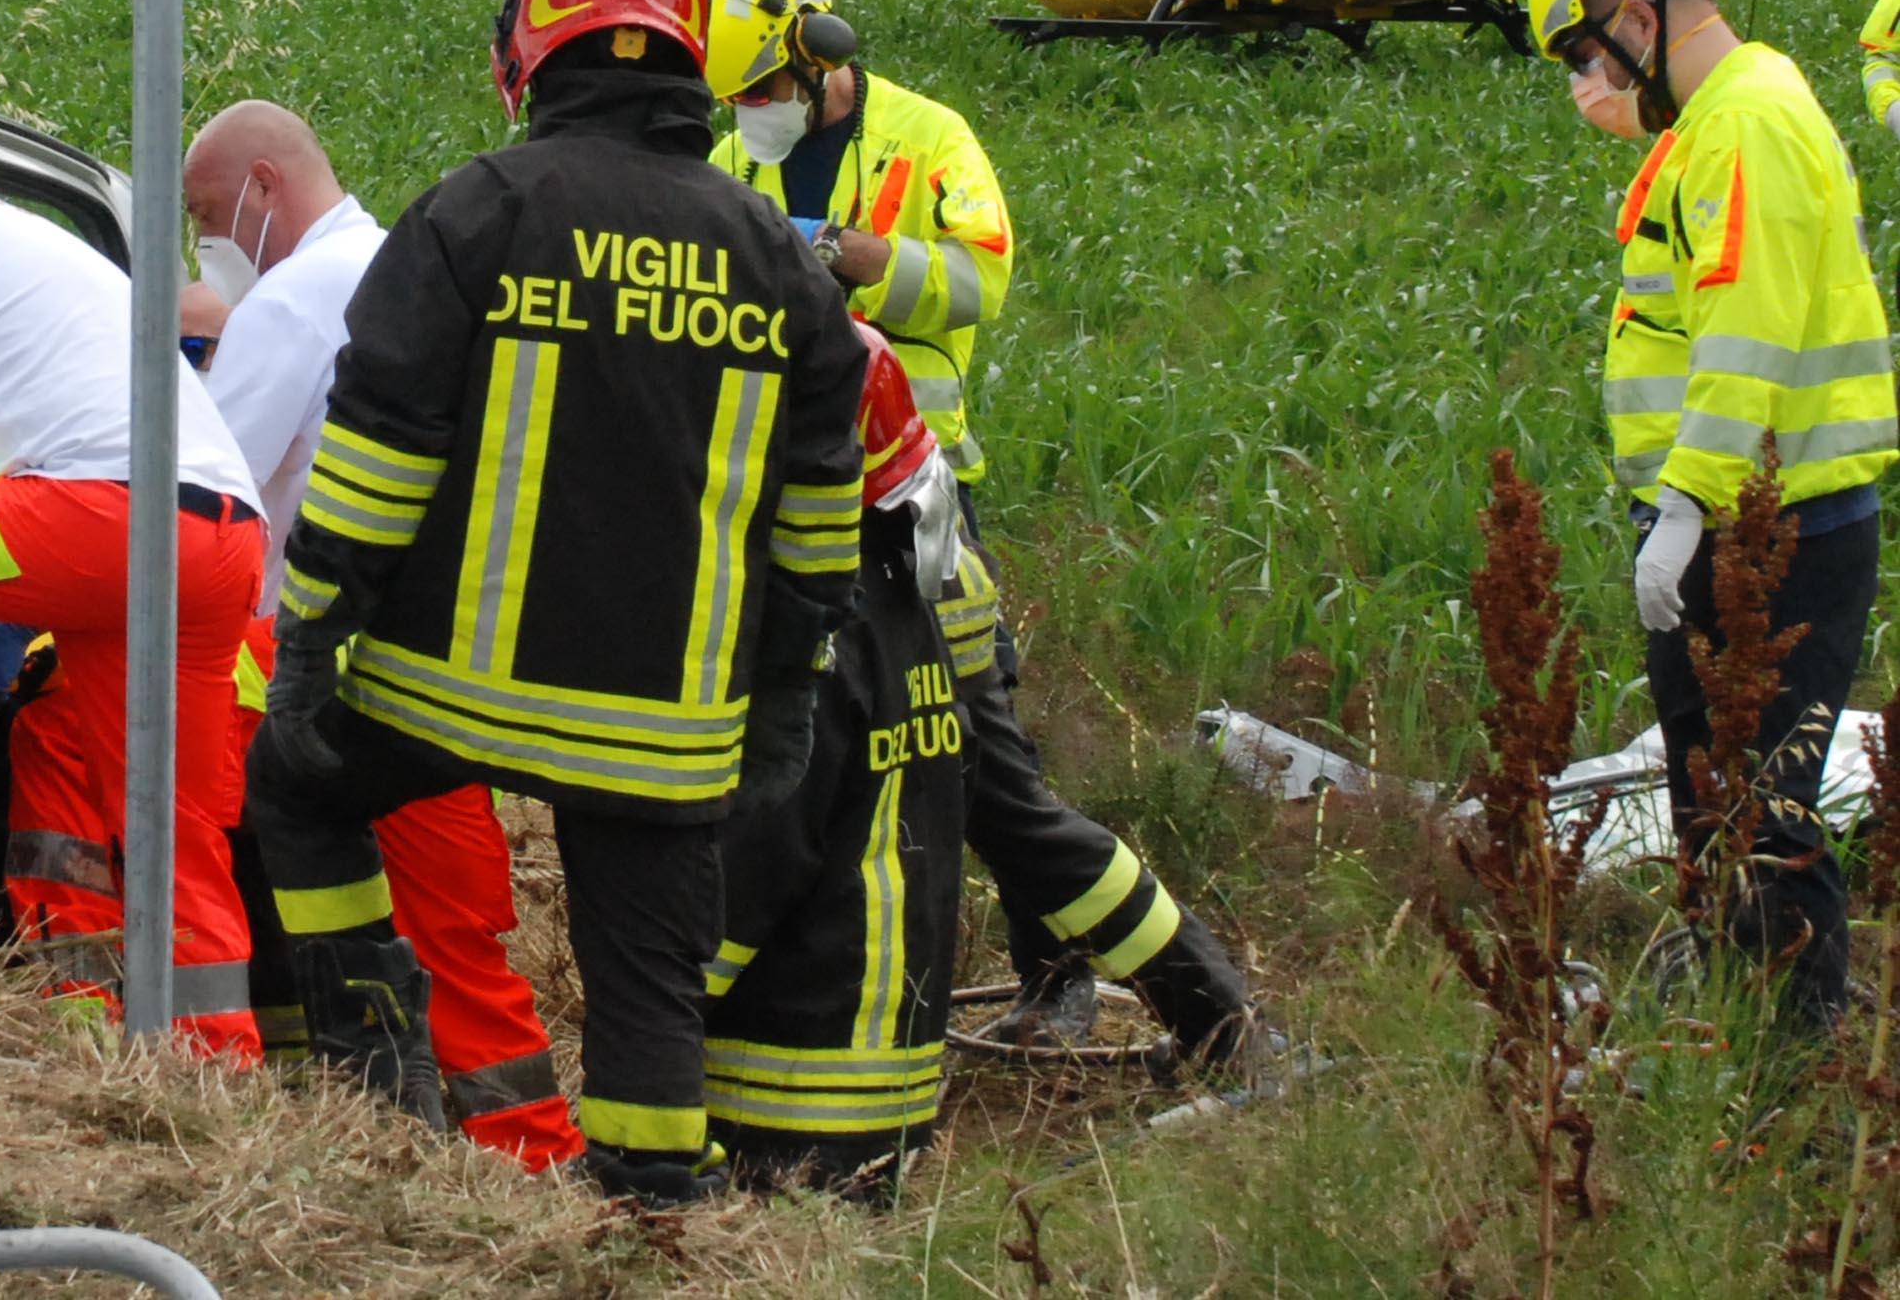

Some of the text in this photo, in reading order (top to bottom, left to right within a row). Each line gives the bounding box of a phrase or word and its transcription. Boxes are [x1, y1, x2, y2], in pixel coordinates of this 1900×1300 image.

[573, 228, 728, 295] VIGILI
[486, 274, 588, 330] DEL
[912, 710, 961, 757] UO
